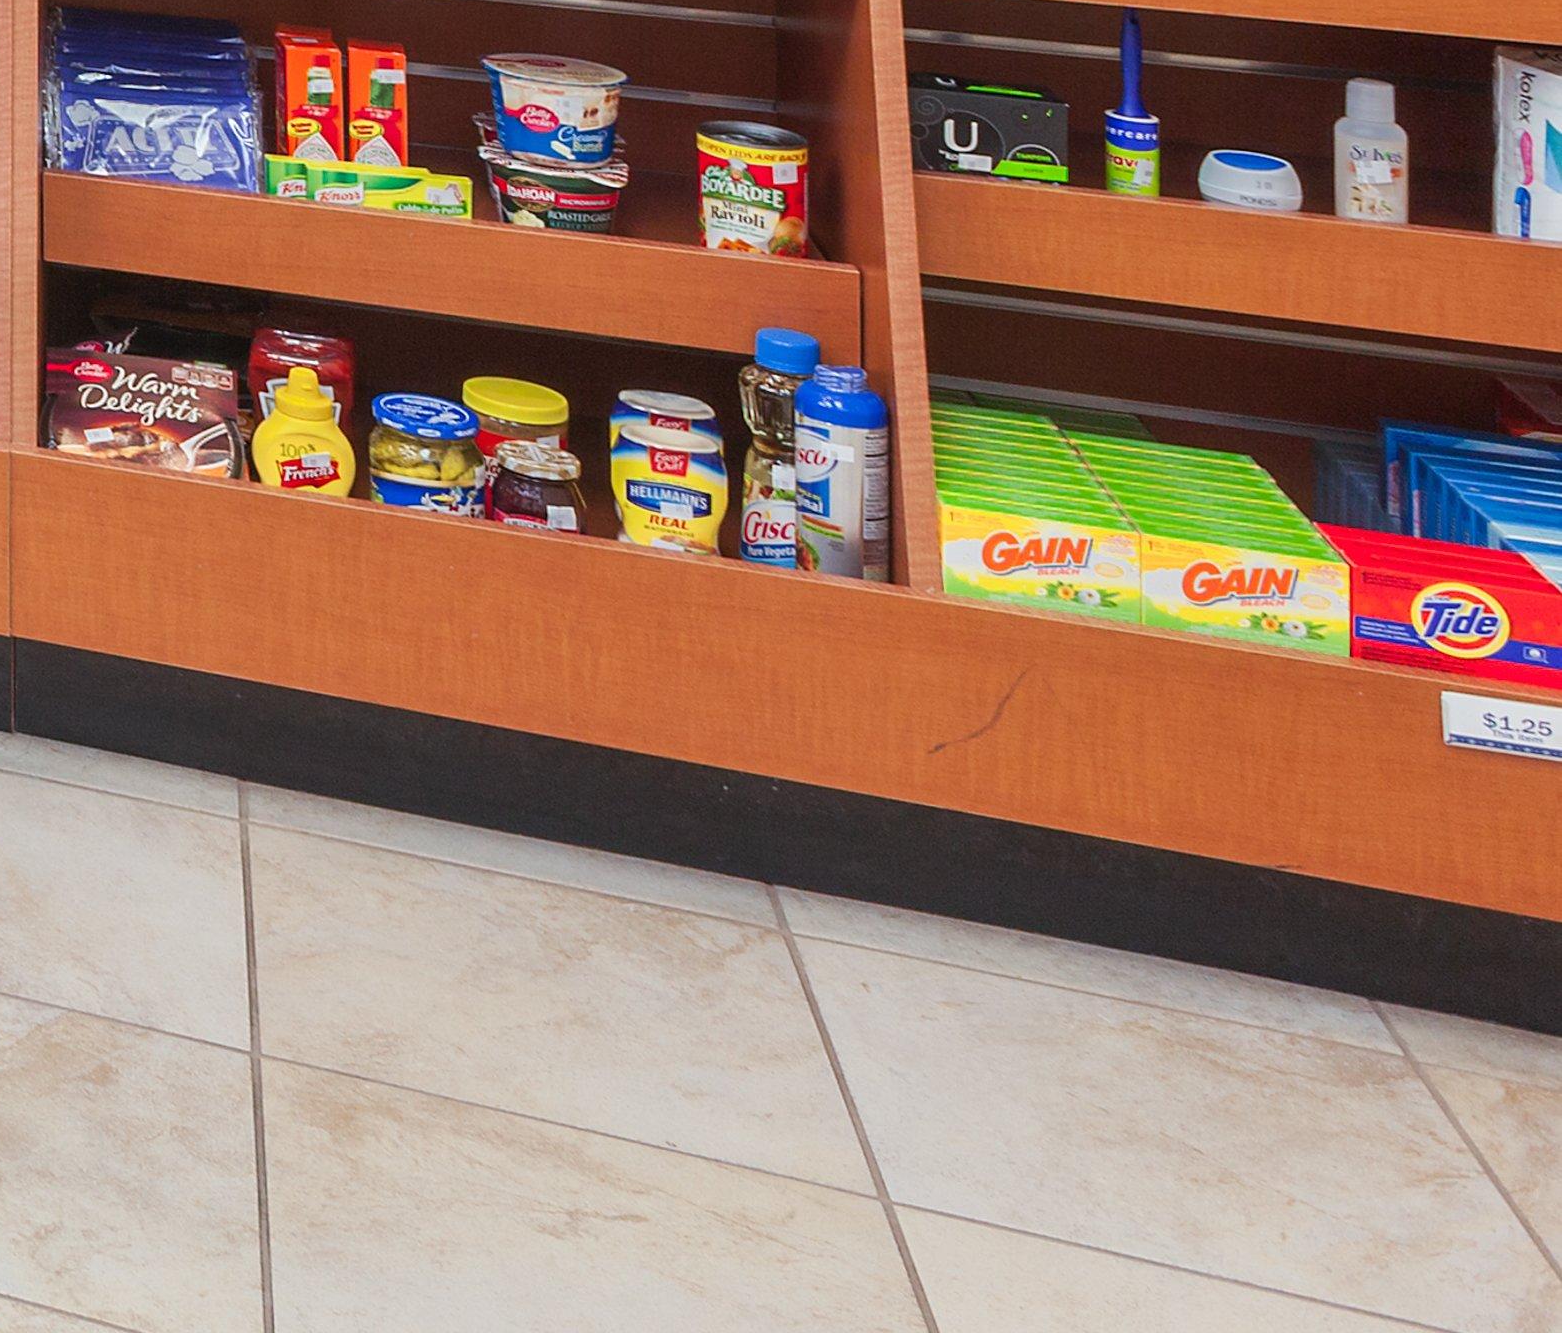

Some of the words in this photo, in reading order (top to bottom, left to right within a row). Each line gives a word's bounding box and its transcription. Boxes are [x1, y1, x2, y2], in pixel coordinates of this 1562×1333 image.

[1519, 71, 1533, 123] kotex
[506, 184, 556, 203] IDAHOAN
[701, 175, 785, 209] BOYARDEE
[710, 205, 765, 230] Ravioli
[111, 365, 199, 401] Warm
[77, 385, 204, 427] Delights
[653, 452, 686, 465] Easy
[649, 515, 689, 530] REAL
[744, 511, 795, 545] Crisc
[982, 530, 1093, 573] GAIN
[1037, 567, 1081, 577] BLEACH
[1182, 561, 1299, 605] GAIN
[1240, 597, 1285, 608] BLEACH
[1420, 602, 1500, 639] Tide
[1483, 710, 1555, 738] $1.25
